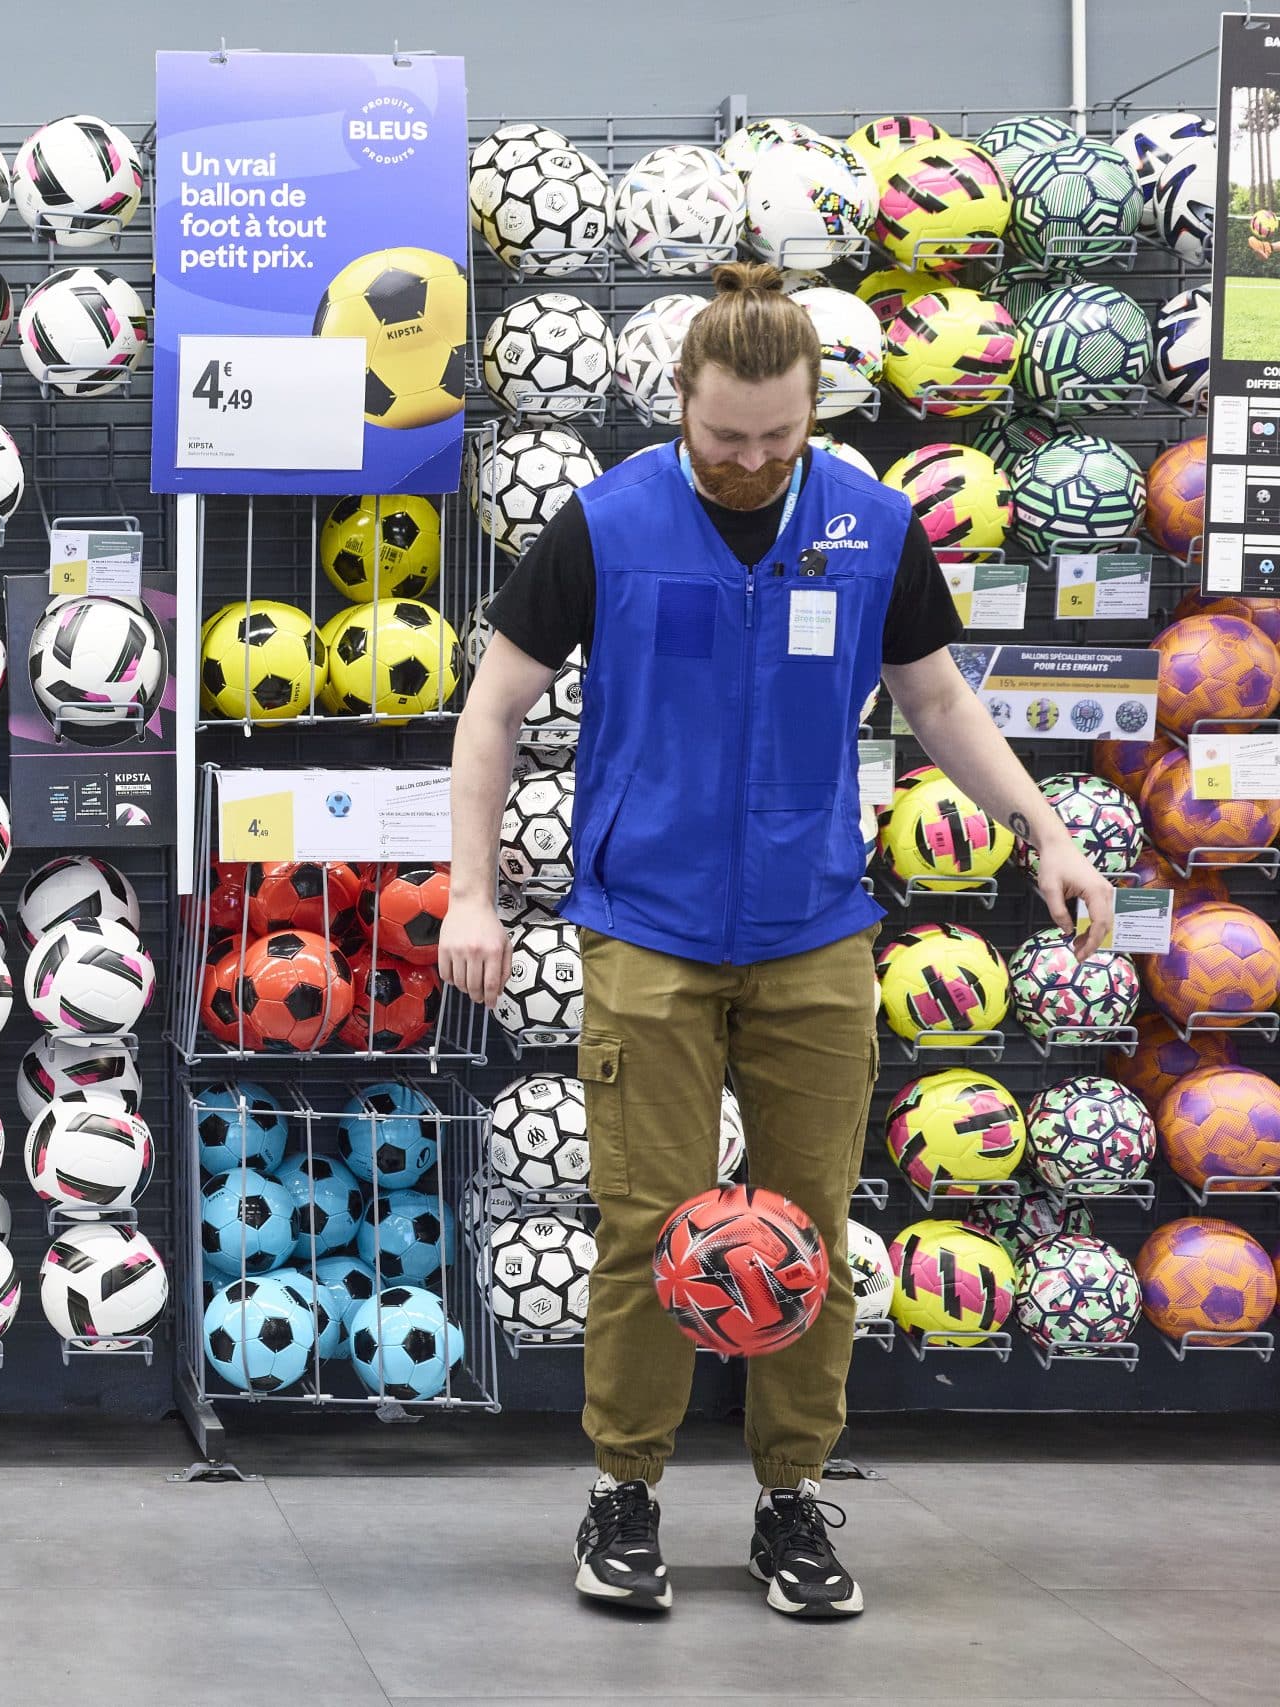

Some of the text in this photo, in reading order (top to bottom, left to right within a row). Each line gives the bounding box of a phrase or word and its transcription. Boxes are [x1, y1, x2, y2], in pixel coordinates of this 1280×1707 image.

[362, 97, 414, 114] PRODUITS
[348, 120, 428, 141] BLEUS
[362, 146, 415, 164] PRODUITS
[181, 152, 276, 177] Un vrai
[180, 182, 306, 207] ballon de
[687, 206, 710, 226] KIPSTA
[180, 212, 326, 238] foot à tout
[180, 244, 314, 273] petit prix.
[386, 325, 423, 340] KIPSTA
[1264, 366, 1280, 376] CO
[813, 540, 868, 551] DECATHLON
[1021, 652, 1122, 663] BALLONS SPÉCIALEMENT CONÇUS
[1033, 662, 1109, 672] POUR LES ENFANTS
[114, 773, 151, 783] KIPSTA
[501, 820, 520, 831] KIPST
[490, 1197, 513, 1208] KIPST
